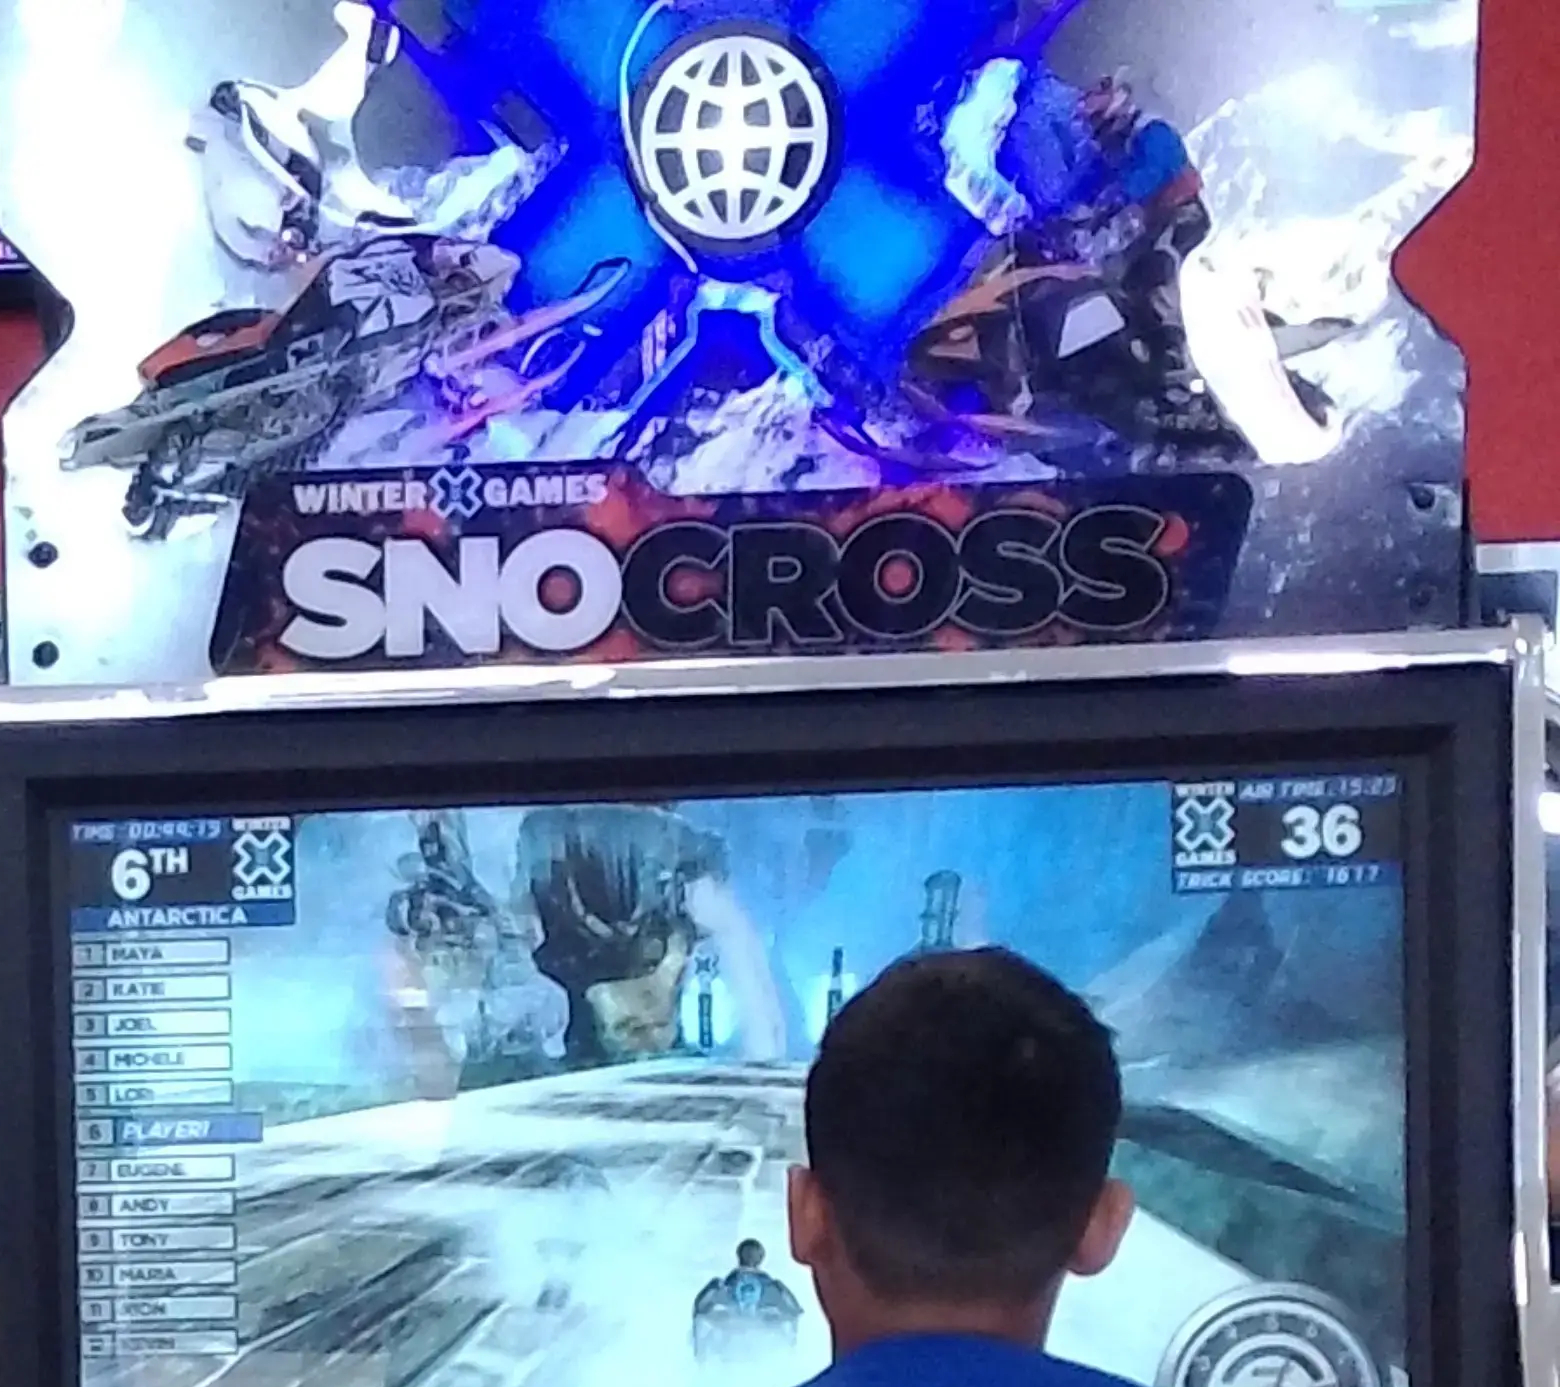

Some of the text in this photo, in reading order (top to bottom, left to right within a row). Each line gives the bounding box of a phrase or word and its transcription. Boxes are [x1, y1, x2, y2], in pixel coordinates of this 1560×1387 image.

[293, 480, 429, 515] WINTER
[483, 473, 608, 508] GAMES
[1280, 803, 1363, 859] 36
[1178, 872, 1233, 890] TRICK
[107, 906, 248, 929] ANTARCTICA
[119, 1198, 170, 1212] ANDY
